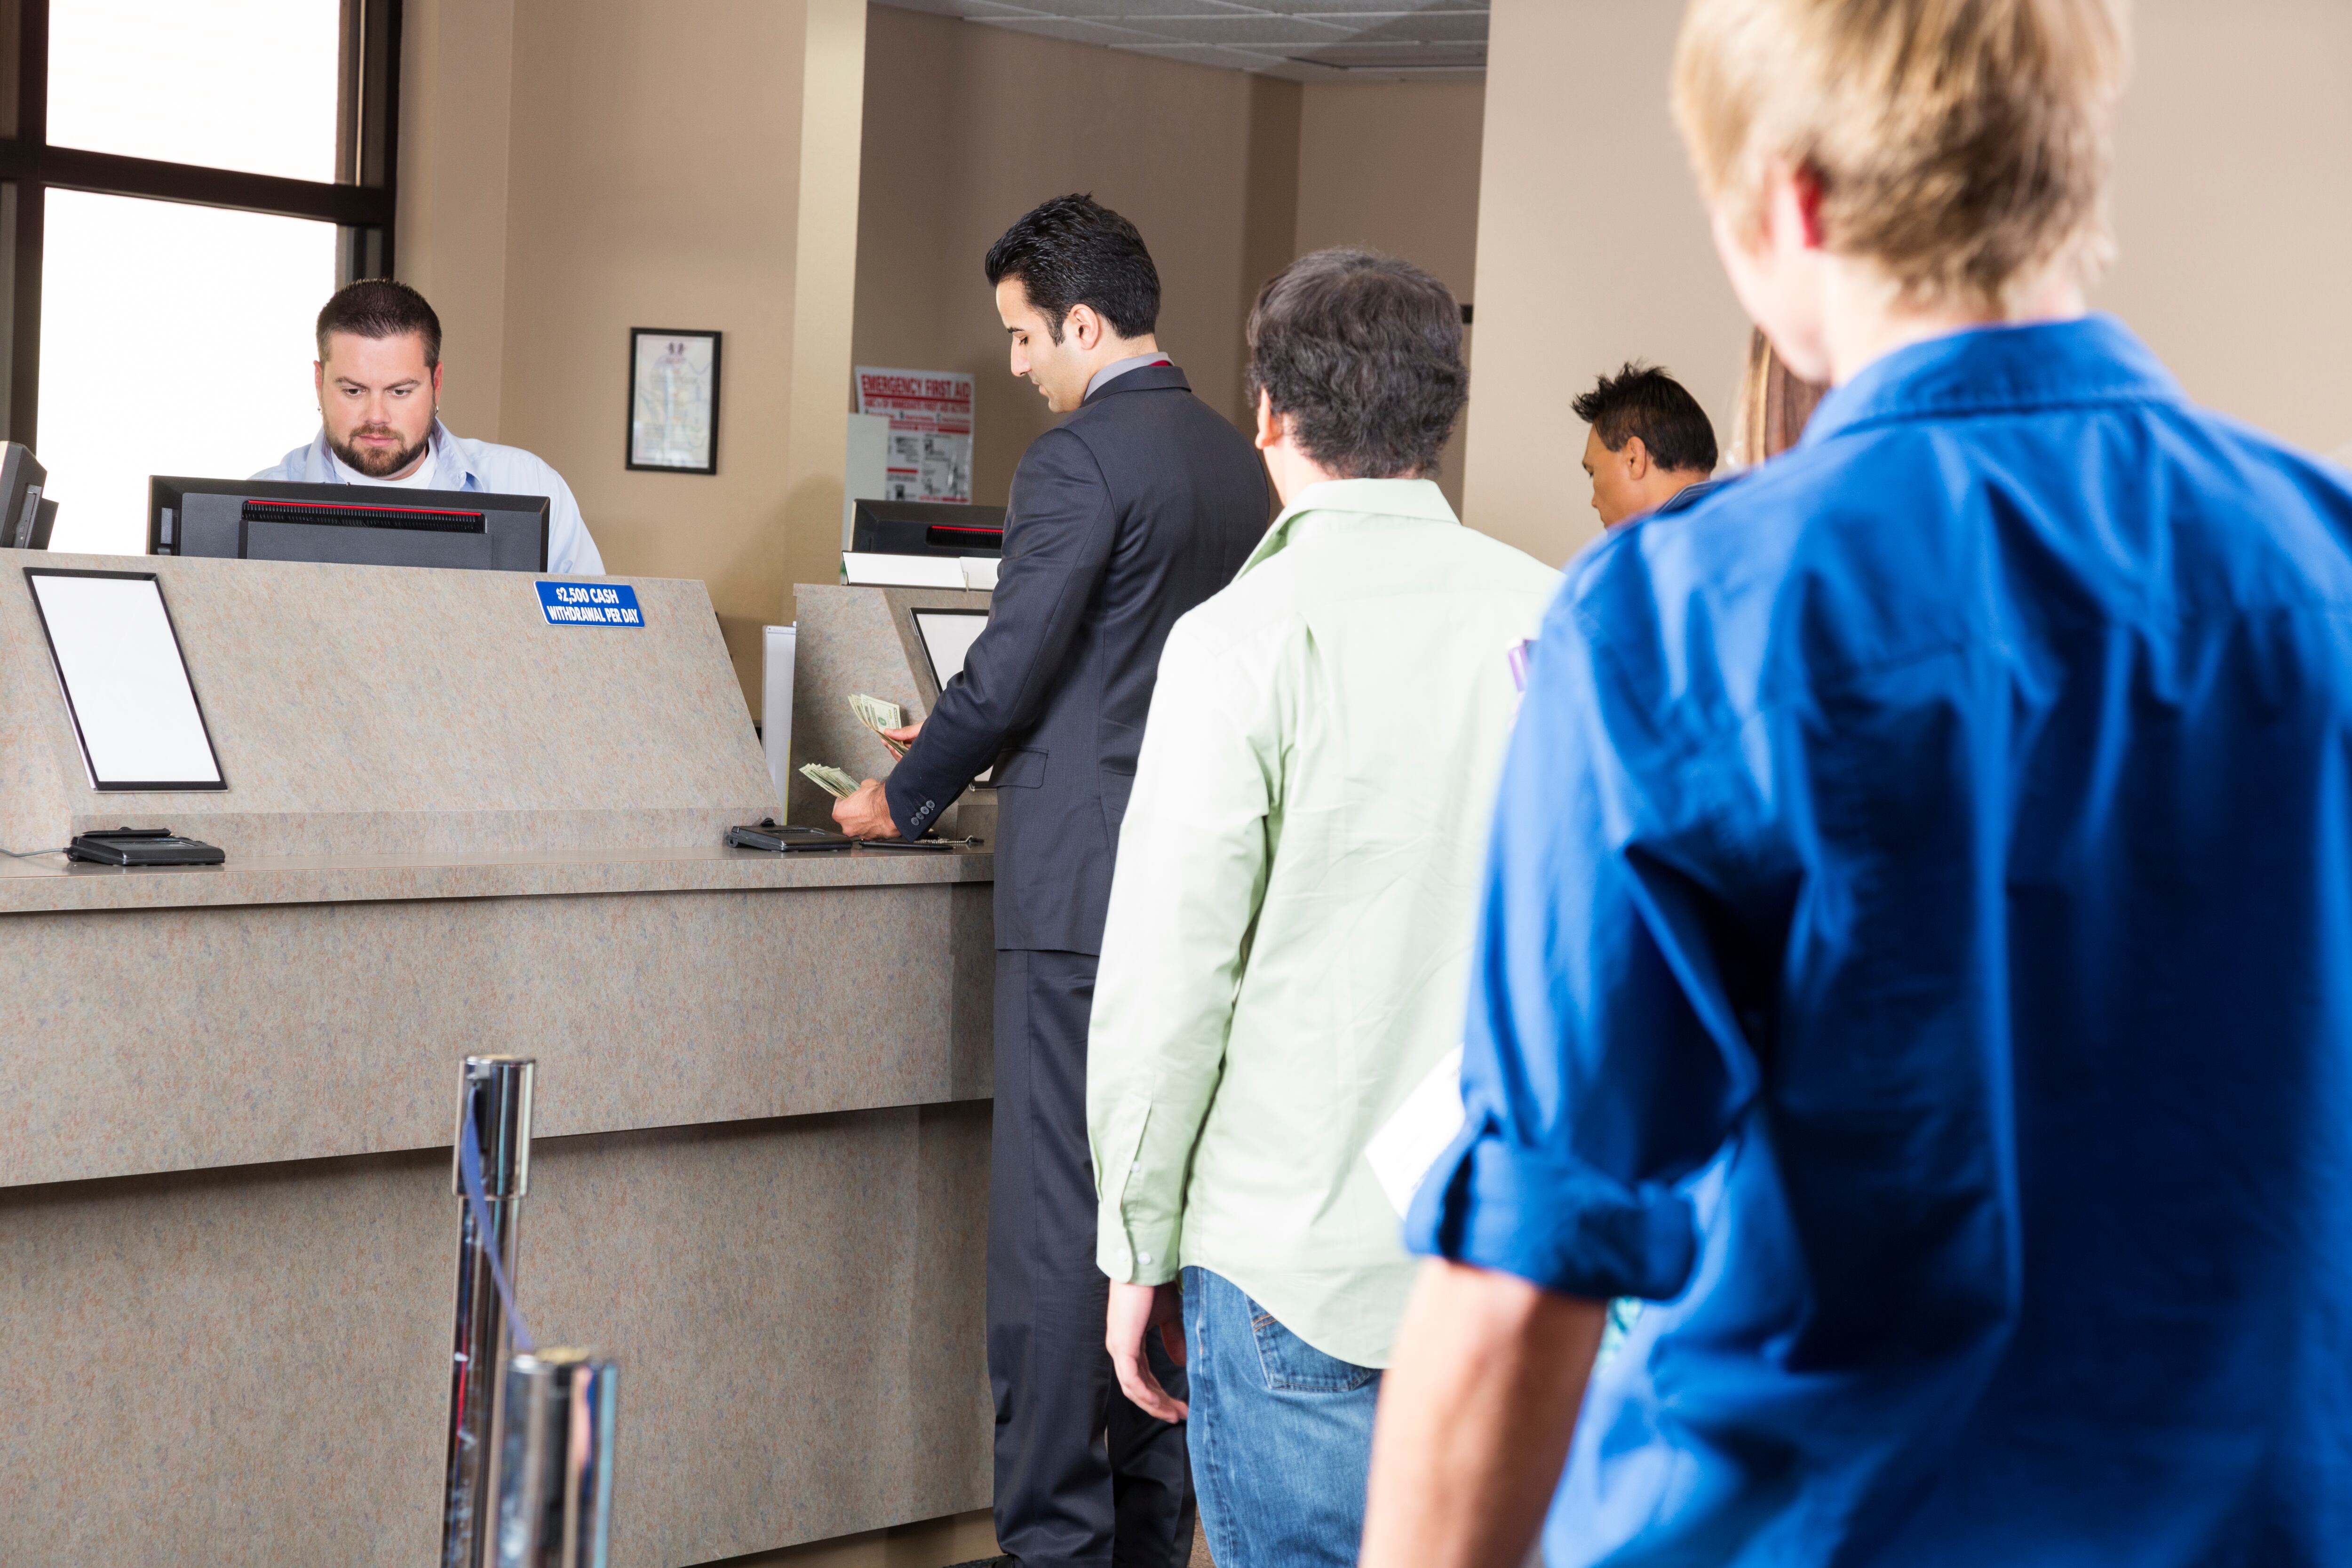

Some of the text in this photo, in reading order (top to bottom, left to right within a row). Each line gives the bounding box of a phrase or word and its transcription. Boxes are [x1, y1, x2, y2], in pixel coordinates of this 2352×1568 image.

[861, 374, 971, 398] EMERGENCY FIRST AID
[556, 587, 619, 604] $2,500 CASH
[547, 606, 639, 623] WITHDRAWAL PER DAY
